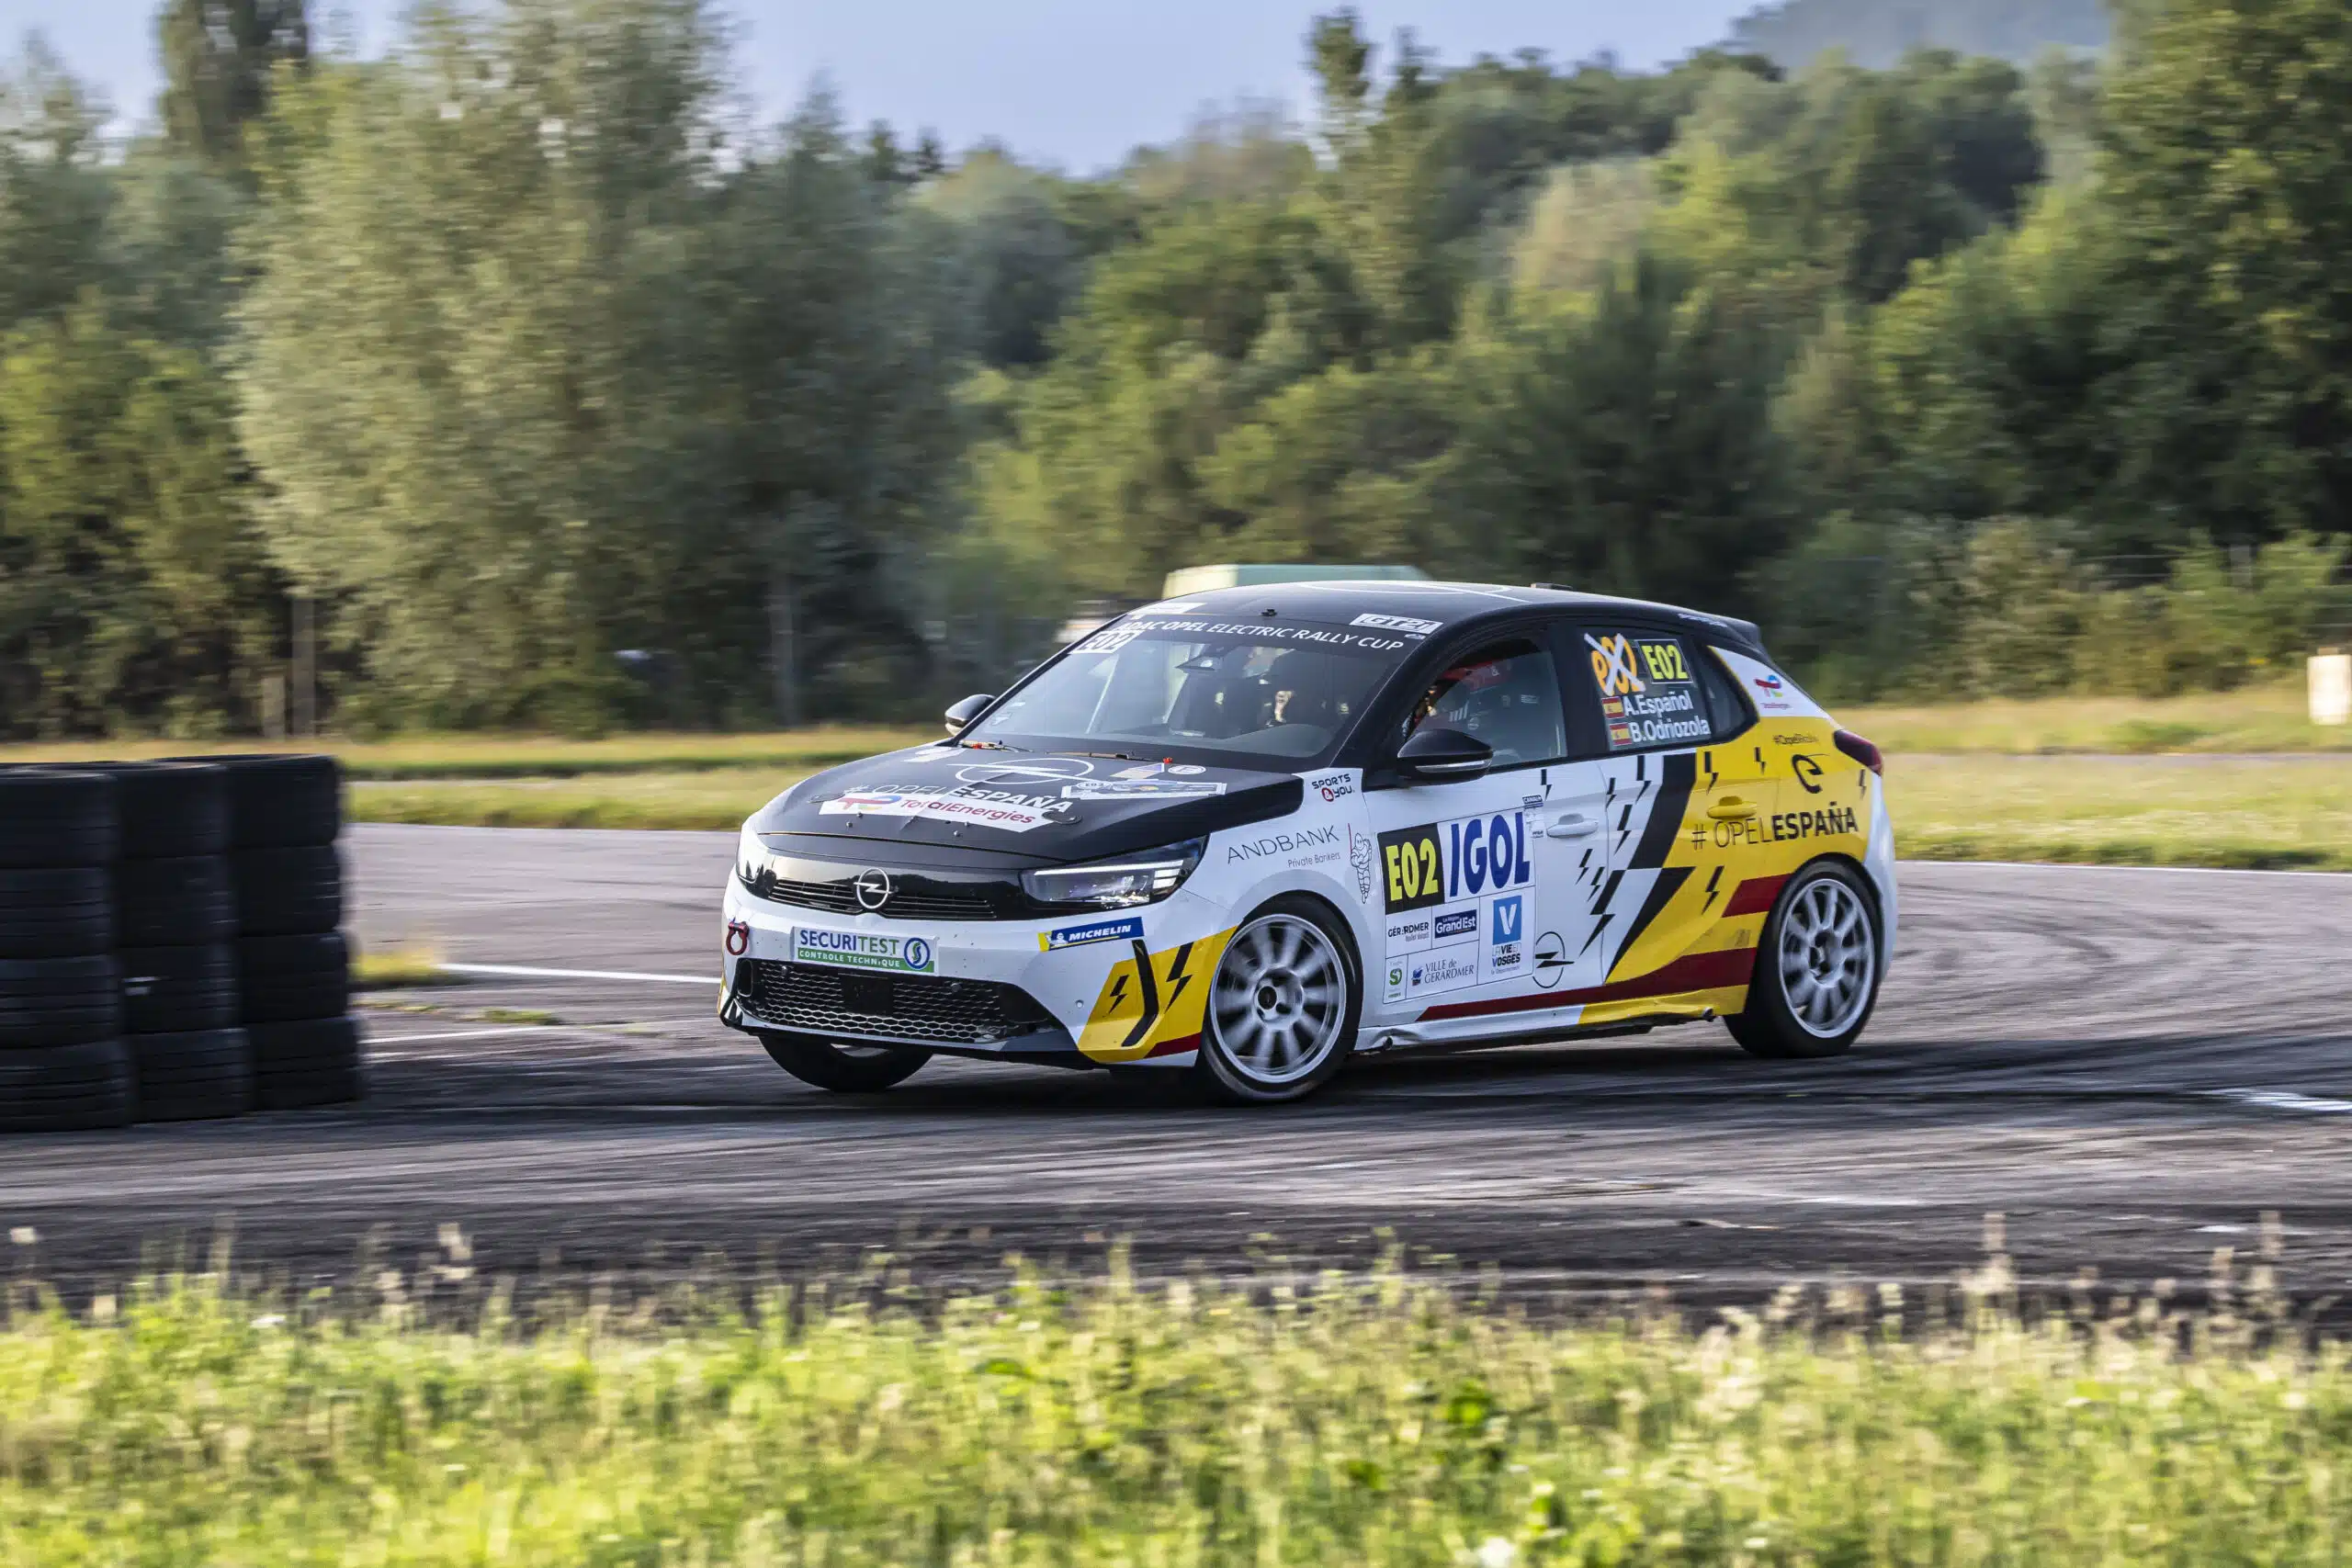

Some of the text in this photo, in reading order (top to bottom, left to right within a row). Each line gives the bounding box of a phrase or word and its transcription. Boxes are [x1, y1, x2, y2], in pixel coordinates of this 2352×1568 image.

[1114, 621, 1404, 650] ADAC OPEL ELECTRIC RALLY CUP
[1641, 644, 1689, 680] E02
[1623, 690, 1693, 718] A.Español
[1628, 716, 1711, 743] B.Odriozola
[1311, 773, 1351, 790] SPORTS
[899, 798, 1036, 825] TotalEnergies
[1227, 825, 1340, 865] ANDBANK
[1385, 811, 1531, 902] E02 IGOL
[1287, 852, 1341, 868] Private Bankers
[799, 929, 900, 955] SECURITEST
[1068, 924, 1133, 942] MICHELIN
[799, 950, 845, 963] CONTROLE
[1425, 958, 1457, 972] VILLE de
[1491, 953, 1521, 967] VOSGES
[1424, 964, 1475, 984] GERARDMER
